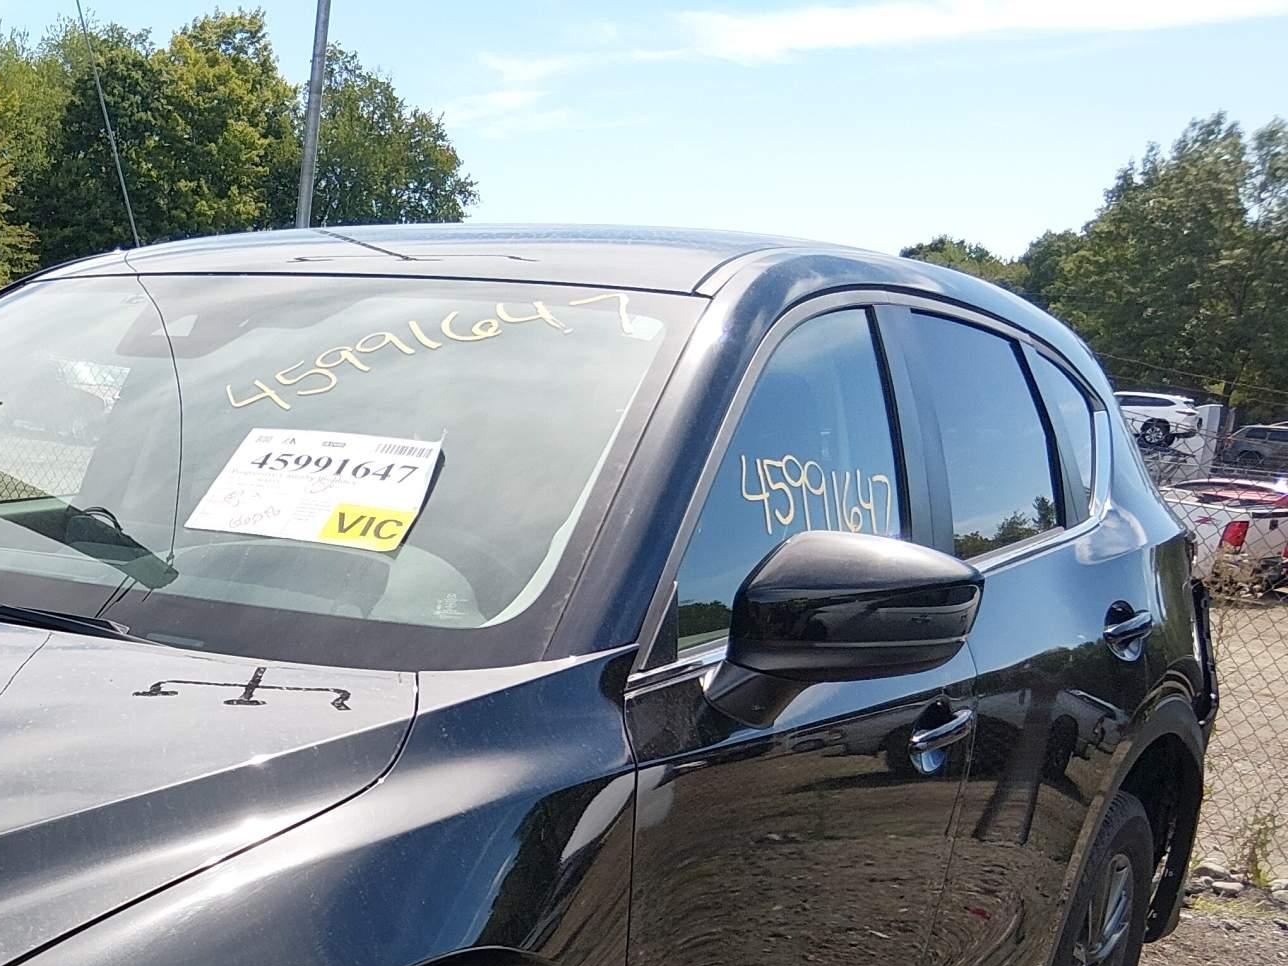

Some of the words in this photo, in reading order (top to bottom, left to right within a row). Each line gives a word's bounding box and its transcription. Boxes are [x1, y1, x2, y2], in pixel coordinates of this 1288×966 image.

[225, 292, 636, 412] 45991647
[250, 451, 419, 484] 45991647
[739, 453, 894, 535] 45991647
[337, 511, 404, 541] VIC
